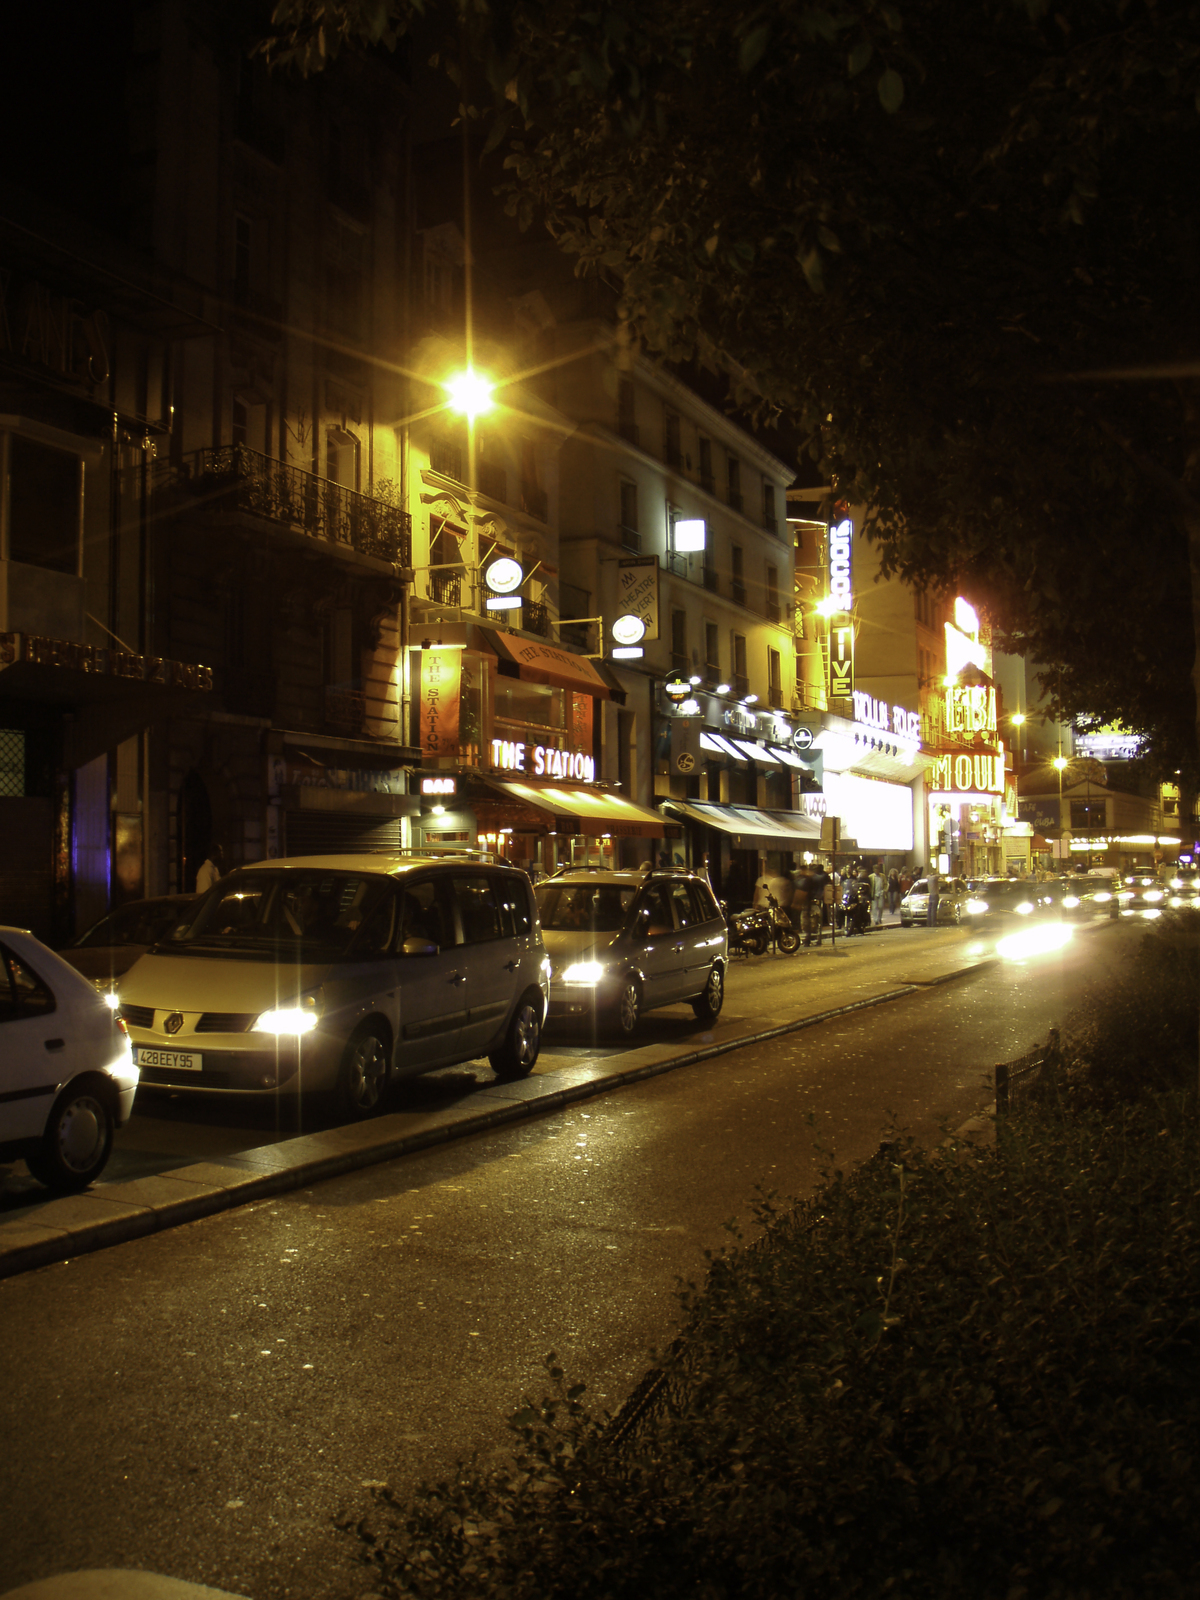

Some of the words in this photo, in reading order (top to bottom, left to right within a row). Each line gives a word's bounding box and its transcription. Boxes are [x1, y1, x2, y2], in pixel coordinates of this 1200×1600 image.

[619, 575, 656, 609] THEATRE
[428, 656, 442, 683] THE
[519, 646, 540, 663] THE
[539, 647, 592, 679] STATION
[427, 688, 440, 751] STATION
[492, 740, 525, 770] THE
[535, 747, 595, 781] STATION
[423, 779, 454, 793] BAR
